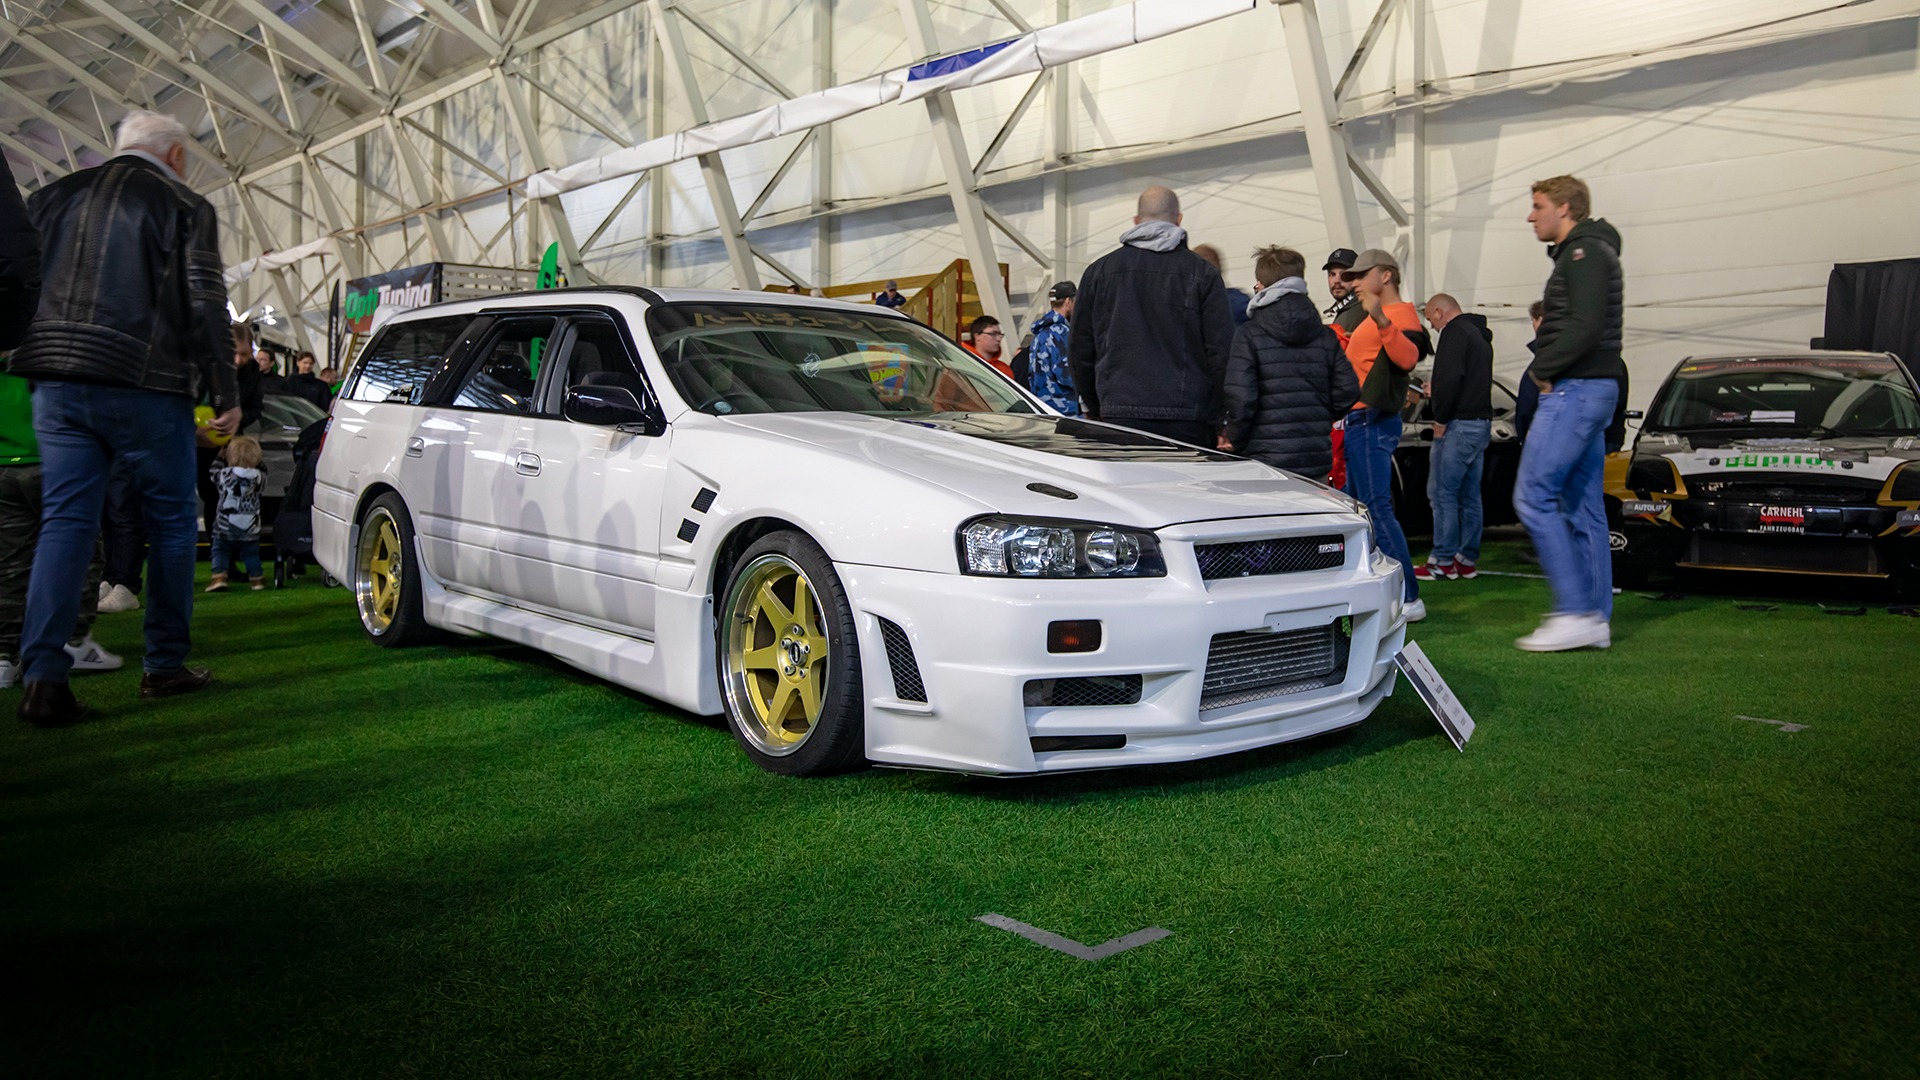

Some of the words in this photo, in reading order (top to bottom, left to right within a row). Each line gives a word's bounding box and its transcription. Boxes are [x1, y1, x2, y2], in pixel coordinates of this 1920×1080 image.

[1332, 294, 1355, 312] PEAK
[1634, 504, 1667, 512] AUTOLIFT
[1760, 506, 1804, 518] CARNEHL
[1760, 525, 1805, 534] FAHRZEUGBAU
